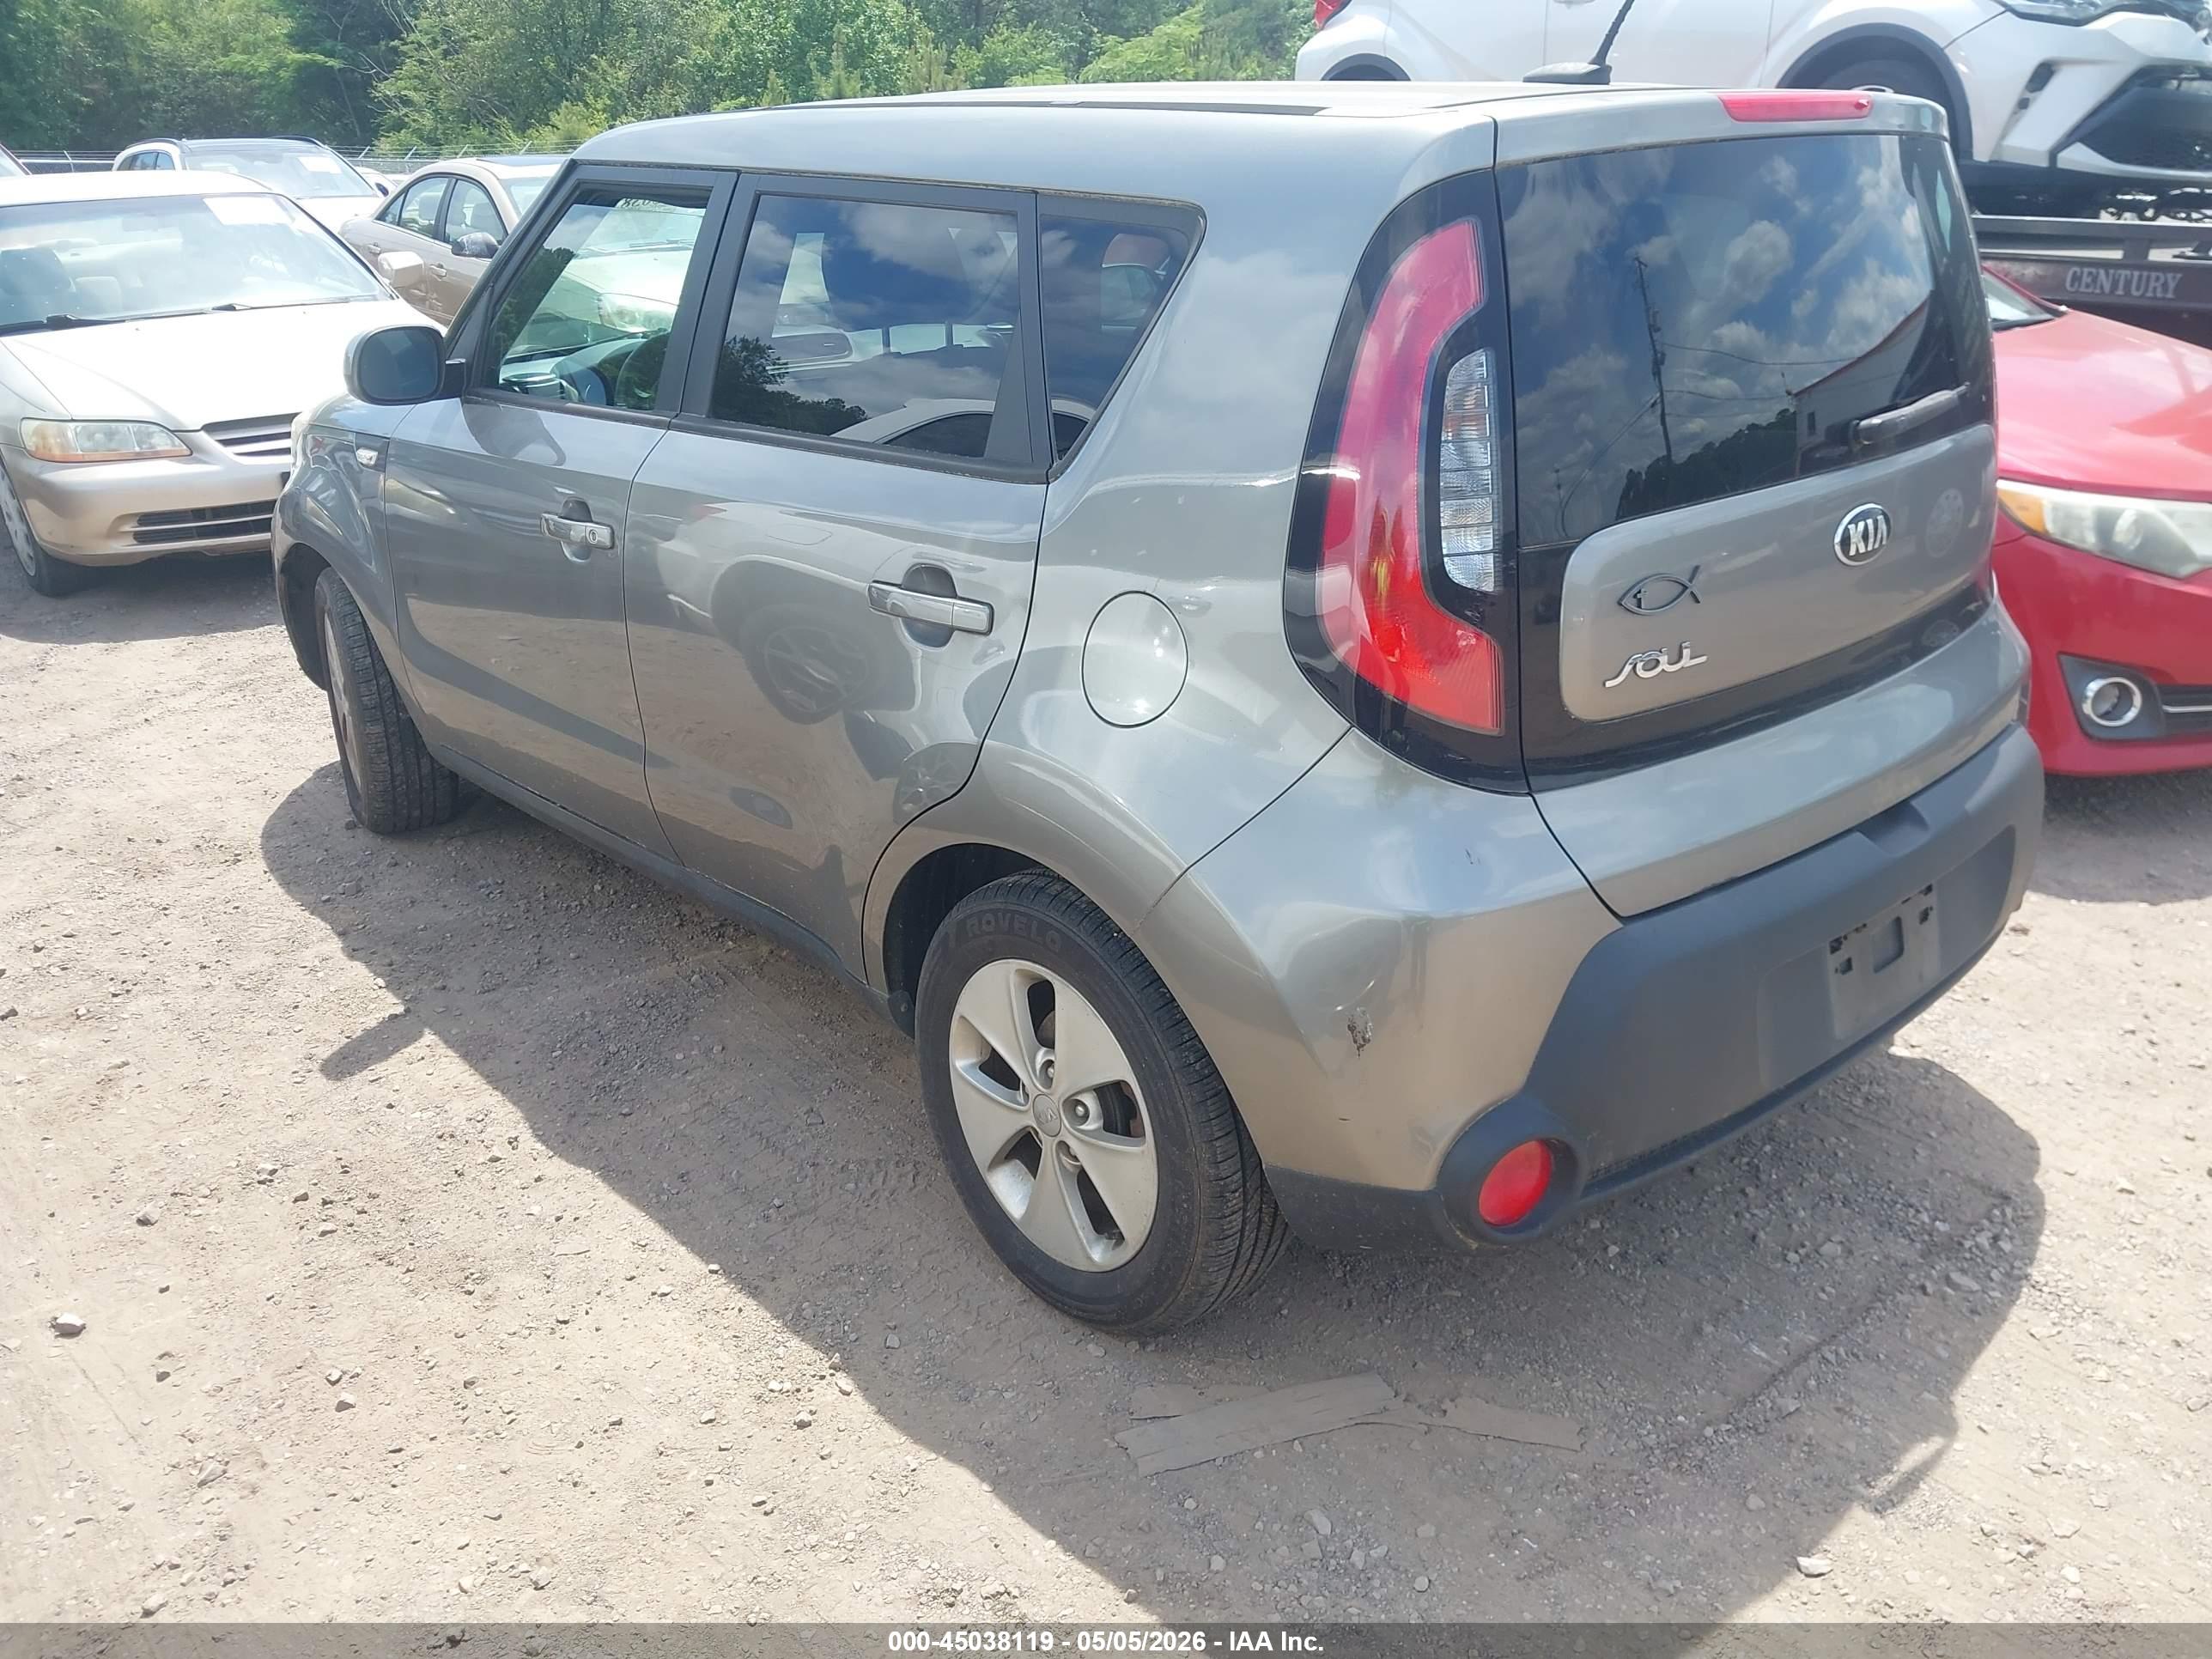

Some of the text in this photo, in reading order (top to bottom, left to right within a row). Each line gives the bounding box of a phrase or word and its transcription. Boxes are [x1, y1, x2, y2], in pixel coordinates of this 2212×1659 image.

[2065, 267, 2182, 299] CENTURY
[1848, 514, 1887, 556] KIA
[966, 912, 1062, 953] ROVELO
